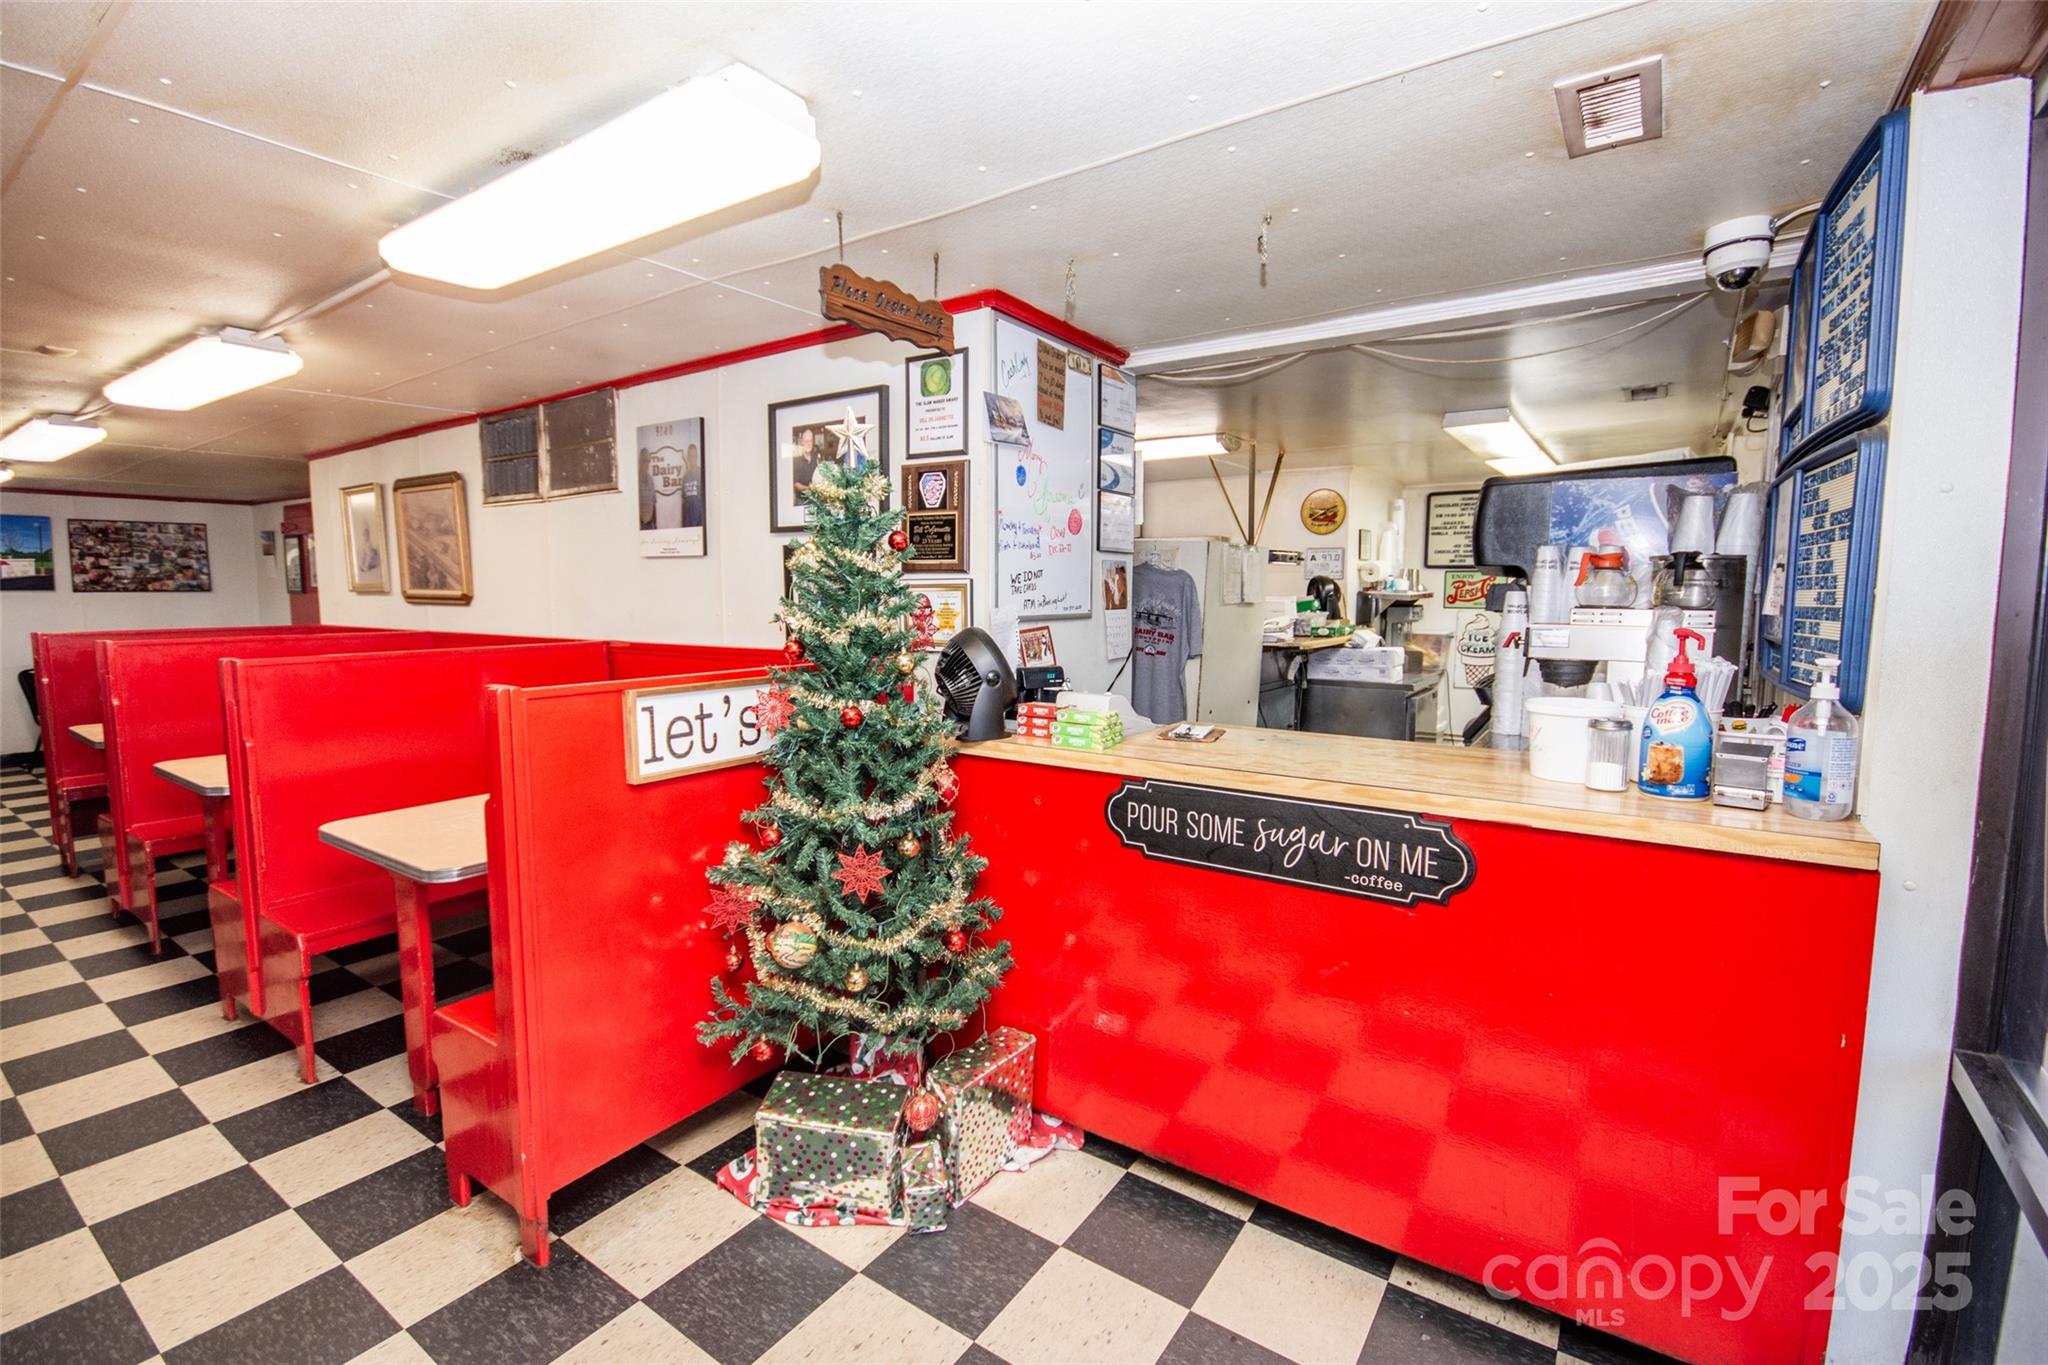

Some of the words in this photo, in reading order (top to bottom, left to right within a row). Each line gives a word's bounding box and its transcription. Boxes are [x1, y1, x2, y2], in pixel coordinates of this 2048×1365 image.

[874, 292, 913, 317] Order
[913, 305, 945, 330] Here
[652, 463, 683, 477] Dairy
[662, 477, 683, 488] Bar
[1310, 554, 1316, 562] A
[1010, 573, 1022, 585] WE
[1023, 570, 1032, 583] DO
[1033, 569, 1044, 579] NOT
[1011, 584, 1023, 595] TAKE
[1023, 599, 1036, 611] ATM
[1157, 631, 1175, 641] BAR
[1468, 633, 1489, 643] ICE
[1461, 643, 1496, 655] CREAM
[1127, 801, 1178, 836] POUR
[1186, 811, 1246, 847] SOME
[1254, 818, 1349, 868] sugar
[1356, 837, 1390, 871] ON
[1400, 842, 1440, 880] ME
[1344, 873, 1403, 892] -coffee
